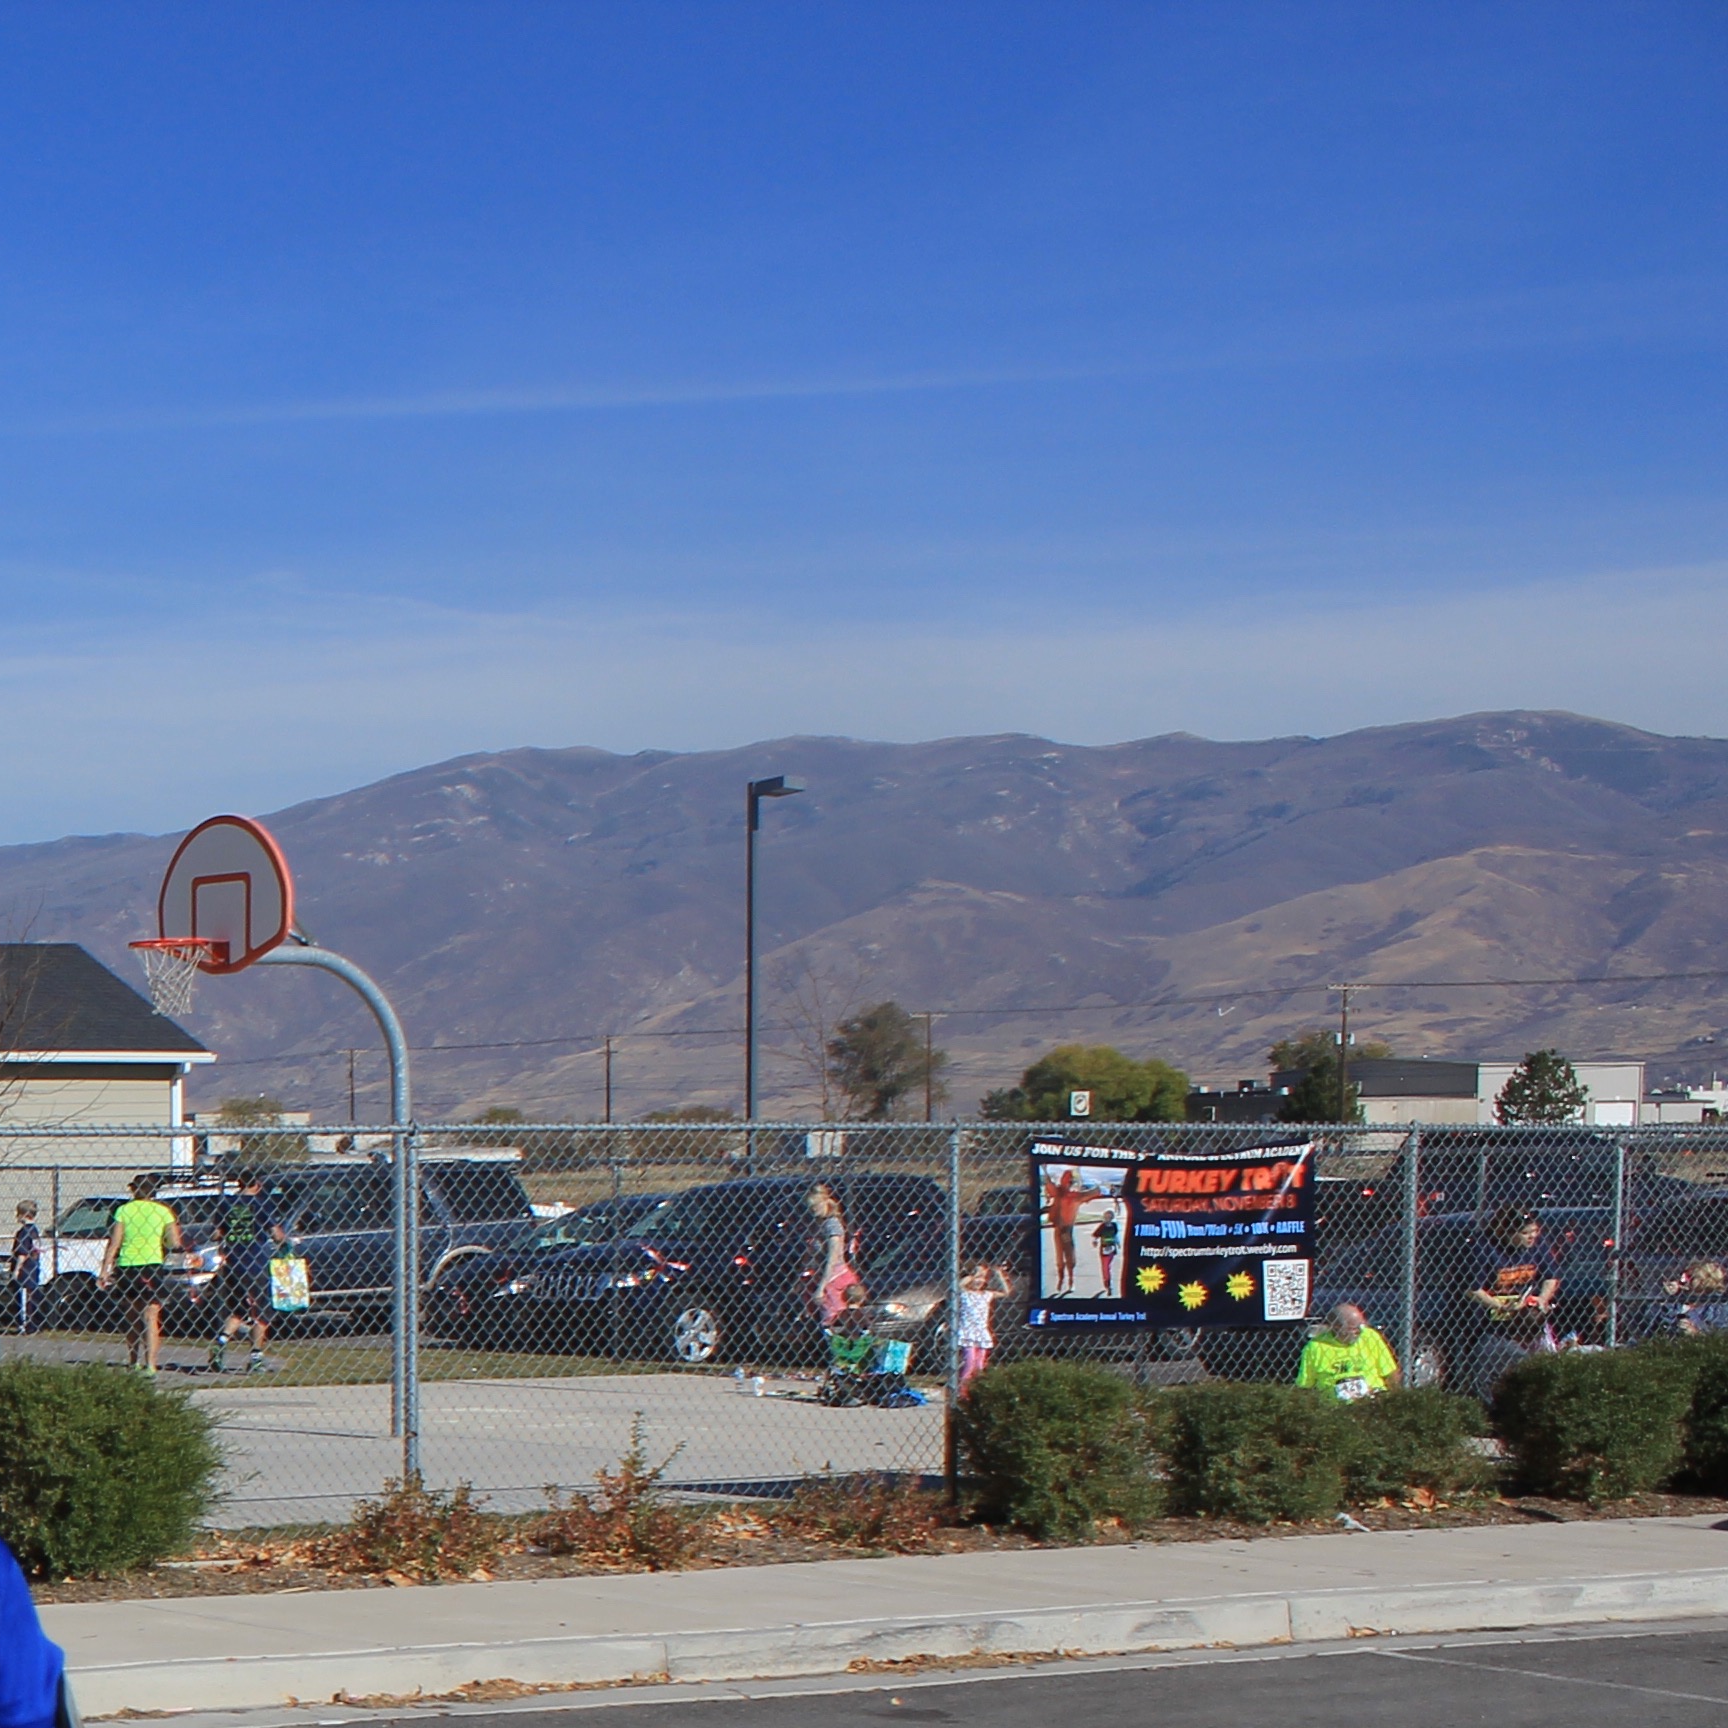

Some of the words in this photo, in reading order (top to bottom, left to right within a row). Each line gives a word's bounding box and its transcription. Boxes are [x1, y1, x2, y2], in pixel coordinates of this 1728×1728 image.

[1032, 1143, 1063, 1155] JOIN
[1063, 1145, 1083, 1157] US
[1083, 1147, 1110, 1158] FOR
[1111, 1149, 1136, 1160] THE
[1136, 1168, 1238, 1194] TURKEY
[1160, 1220, 1186, 1238] FUN
[1276, 1220, 1305, 1234] RAFFLE
